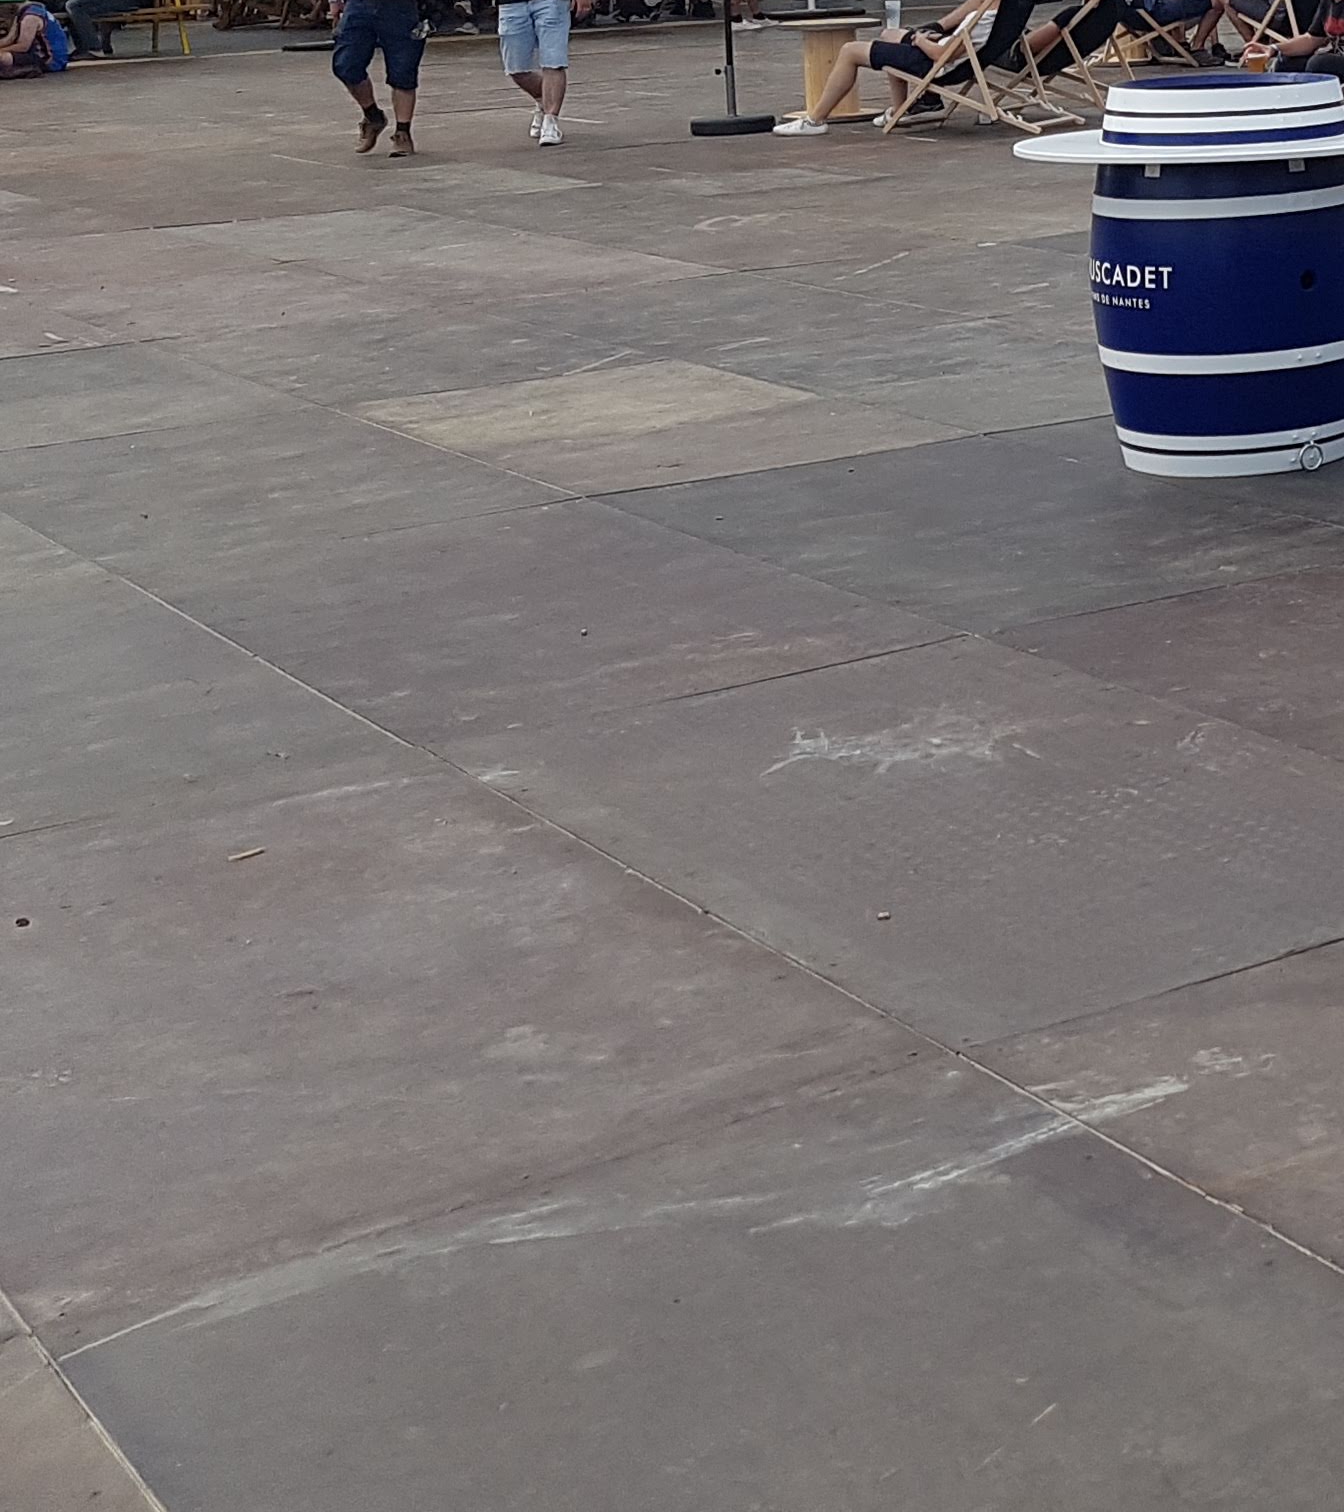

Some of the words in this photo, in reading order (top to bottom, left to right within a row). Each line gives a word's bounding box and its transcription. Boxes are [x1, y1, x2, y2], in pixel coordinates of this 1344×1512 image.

[1090, 257, 1172, 289] USCADET
[1101, 294, 1110, 305] DE
[1112, 295, 1150, 309] NANTES
